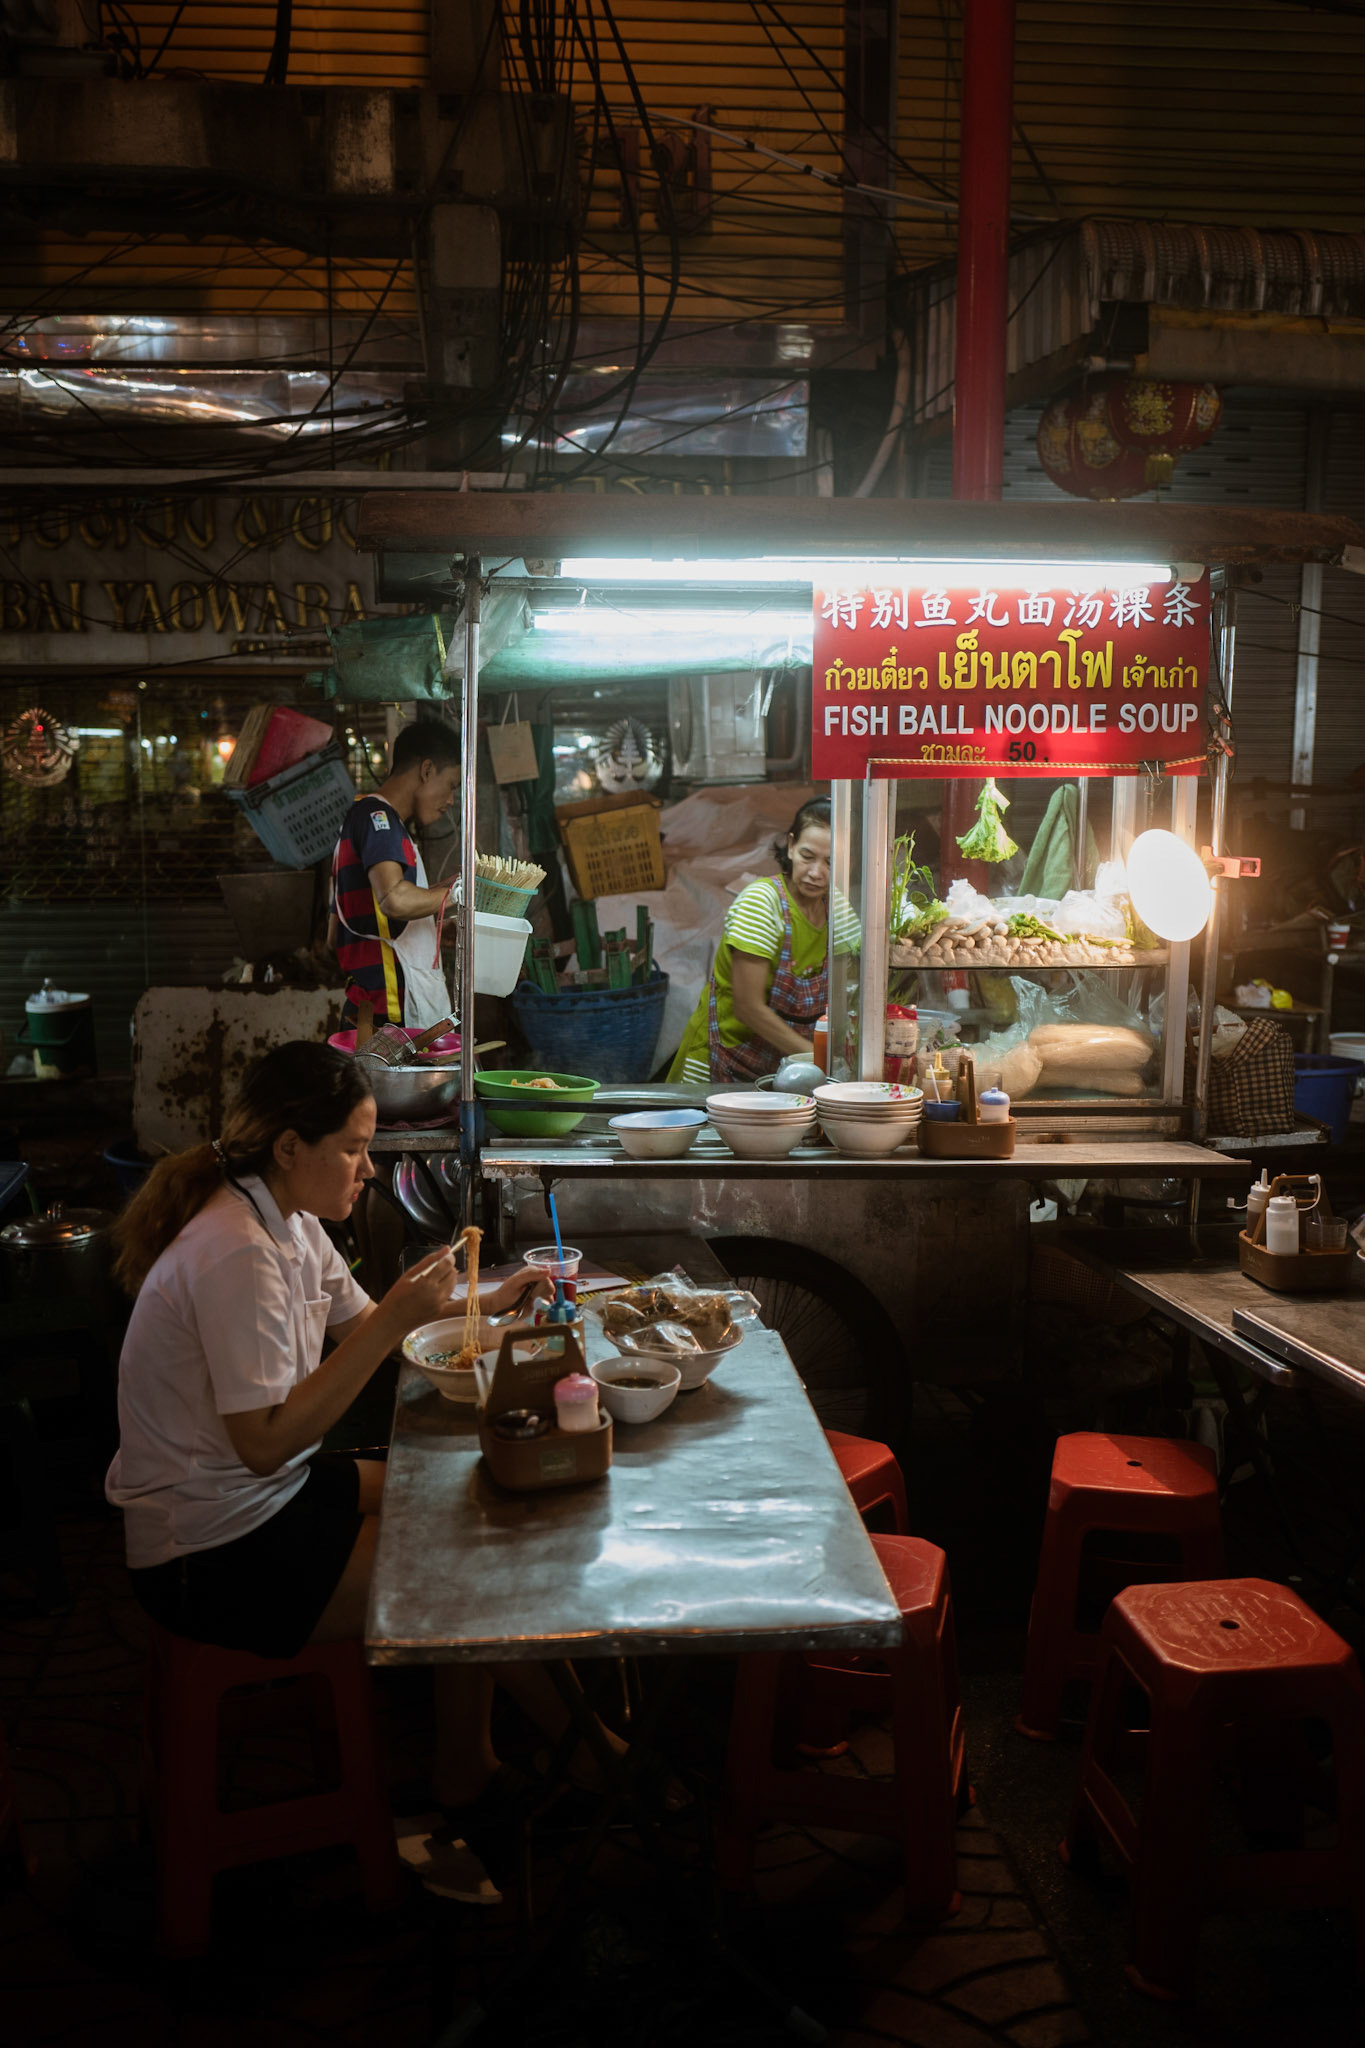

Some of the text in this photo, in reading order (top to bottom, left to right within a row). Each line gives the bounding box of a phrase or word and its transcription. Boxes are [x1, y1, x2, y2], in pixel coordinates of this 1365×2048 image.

[824, 628, 1198, 690] ก๋วยเตี๋ยว เย็นตาโฟ เจ้าเก่า
[824, 703, 1199, 736] FISH BALL NOODLE SOUP
